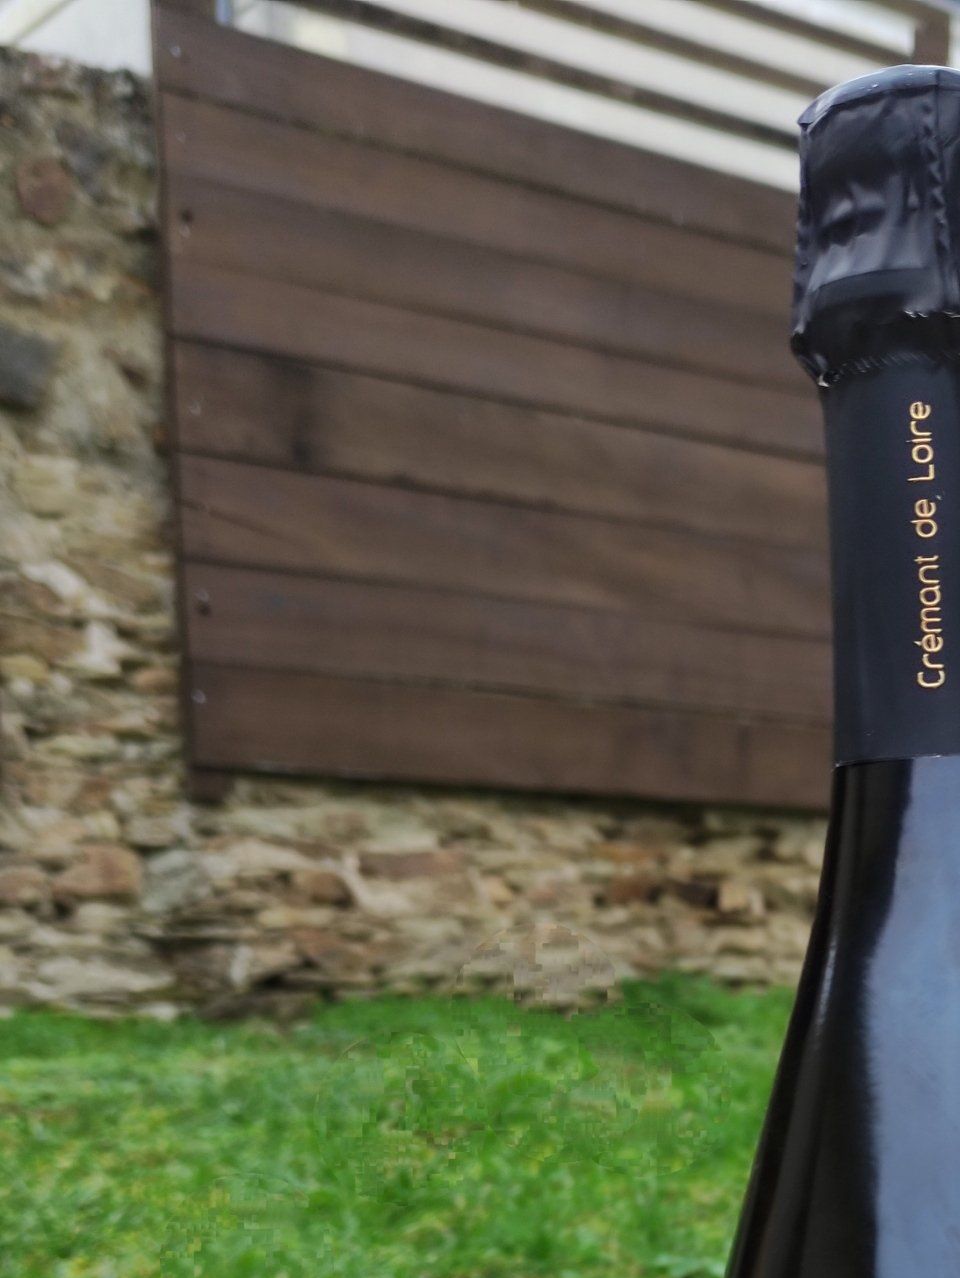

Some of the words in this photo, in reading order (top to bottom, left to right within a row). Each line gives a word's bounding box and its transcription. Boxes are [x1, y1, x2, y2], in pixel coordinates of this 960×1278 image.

[905, 400, 936, 482] Loire
[910, 499, 938, 538] de
[913, 554, 946, 689] Crémant
